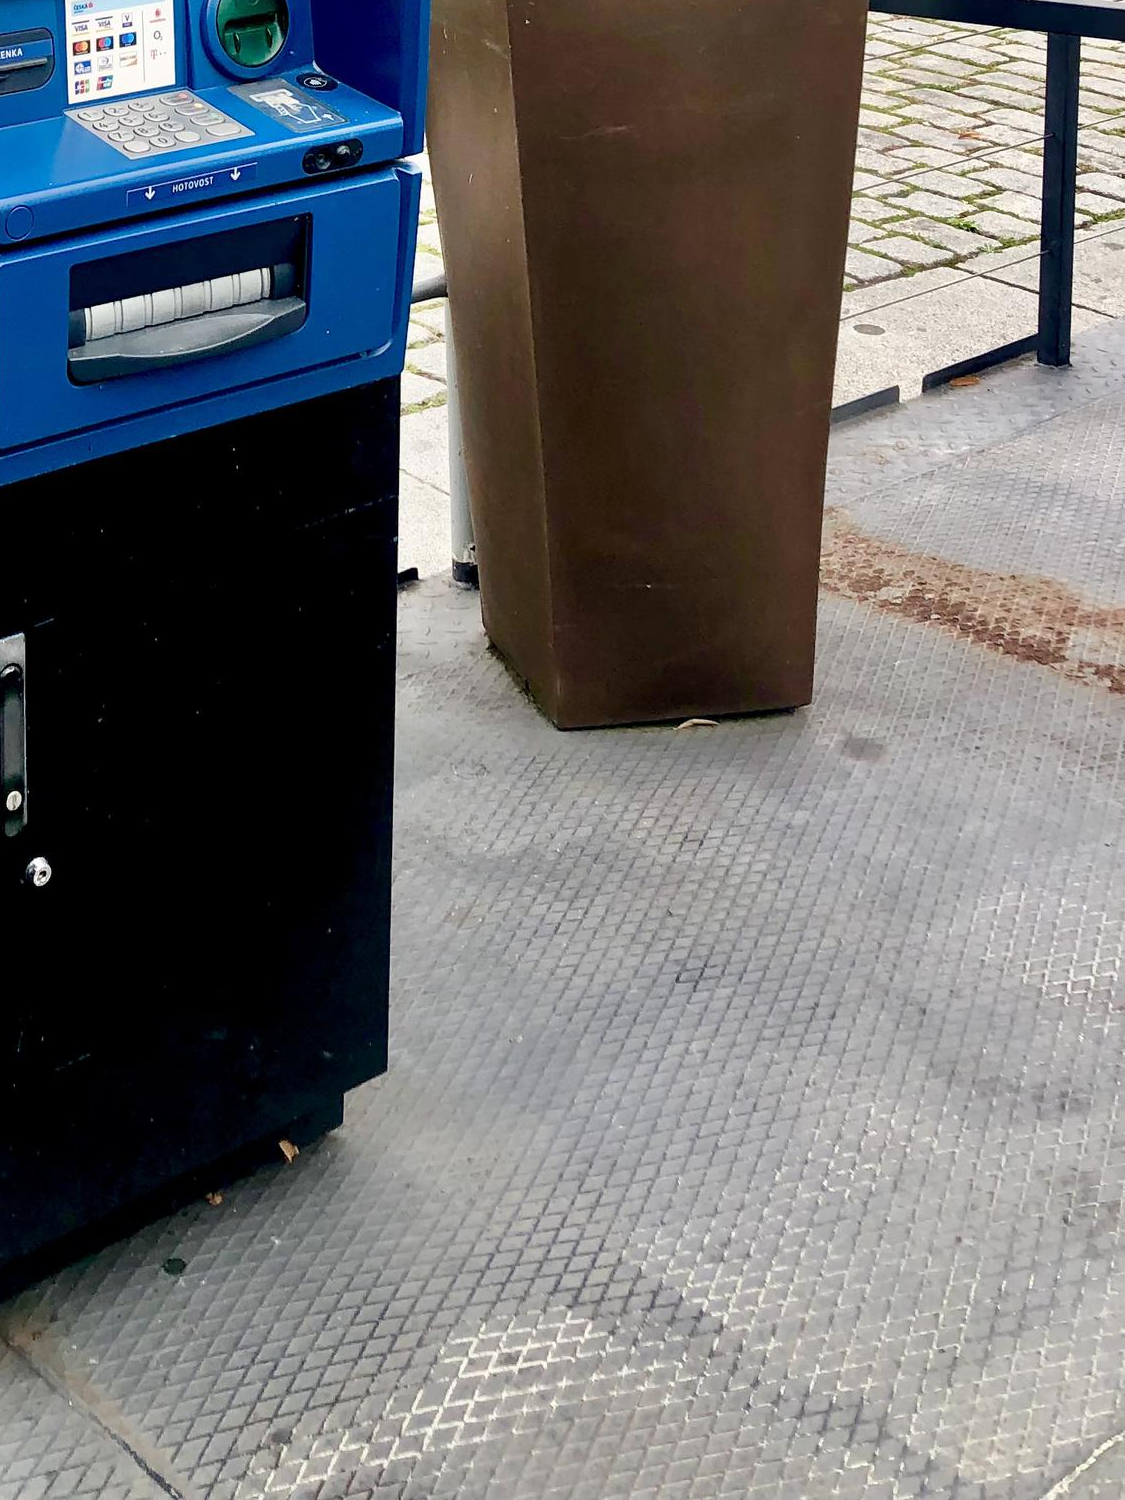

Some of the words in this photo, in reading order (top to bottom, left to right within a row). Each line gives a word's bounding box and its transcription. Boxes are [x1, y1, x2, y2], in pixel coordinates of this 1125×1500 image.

[74, 24, 89, 32] VISA
[98, 20, 111, 28] VISA
[172, 176, 214, 193] HOTOVOST
